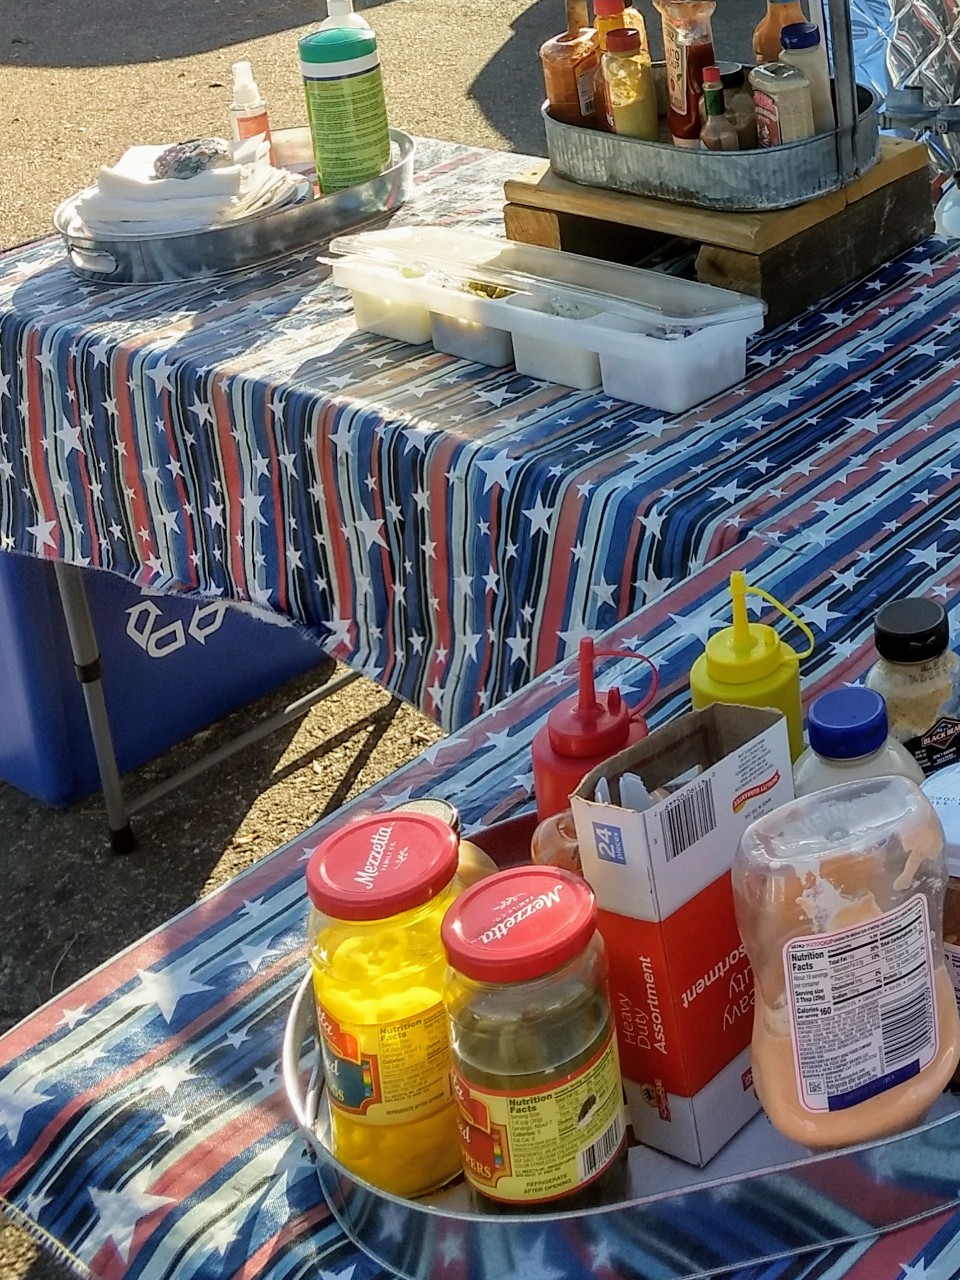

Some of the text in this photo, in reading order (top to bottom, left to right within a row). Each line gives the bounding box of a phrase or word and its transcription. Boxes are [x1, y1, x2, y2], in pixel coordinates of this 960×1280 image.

[922, 730, 947, 746] BLACK
[597, 827, 614, 857] 24
[613, 831, 625, 860] pieces
[354, 824, 393, 891] Mezzetta
[479, 884, 564, 945] Mezzetta
[791, 950, 825, 962] Nutrition
[792, 961, 814, 972] Facts
[794, 990, 814, 998] Serving
[639, 955, 668, 1055] Assortment
[796, 1006, 832, 1016] Calories 160
[379, 1019, 422, 1035] Nutrition
[618, 992, 637, 1046] Heavy
[635, 1007, 652, 1050] Duty
[380, 1032, 408, 1042] Facts
[508, 1094, 553, 1106] Nutrition
[509, 1105, 537, 1114] Facts
[523, 1178, 573, 1195] AFTER OPENING
[526, 1173, 568, 1187] REFRIGERATE
